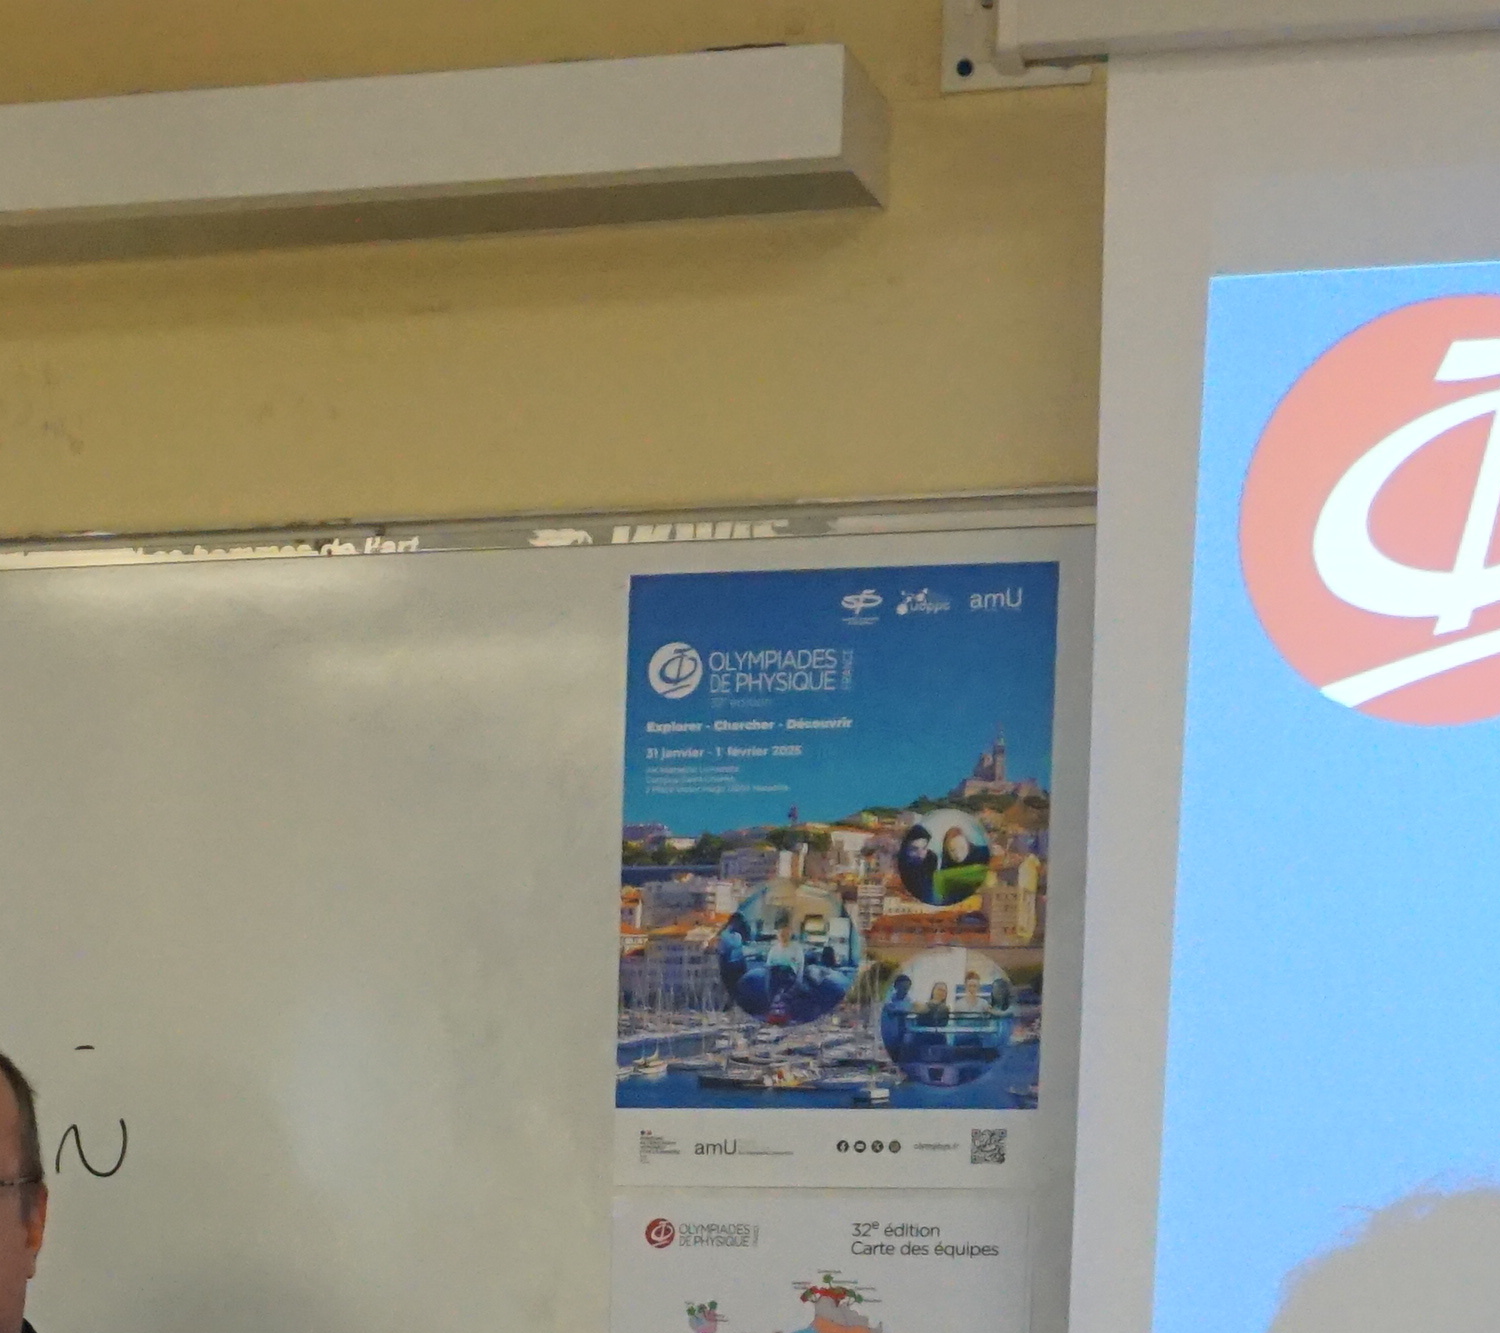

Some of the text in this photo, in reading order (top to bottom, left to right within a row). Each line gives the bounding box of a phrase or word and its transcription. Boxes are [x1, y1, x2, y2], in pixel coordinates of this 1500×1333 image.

[969, 587, 1023, 610] amU
[708, 648, 838, 672] OLYMPIADES
[709, 669, 837, 694] DE PHYSIQUE
[646, 721, 702, 734] Explorer
[713, 719, 775, 731] Chercher
[660, 748, 704, 761] janvier
[694, 1139, 738, 1156] amU
[678, 1223, 751, 1235] OLYMPIADES
[884, 1222, 941, 1238] édition
[678, 1235, 692, 1247] DE
[693, 1235, 750, 1247] PHYSIQUE
[851, 1240, 999, 1259] Carte des équipes
